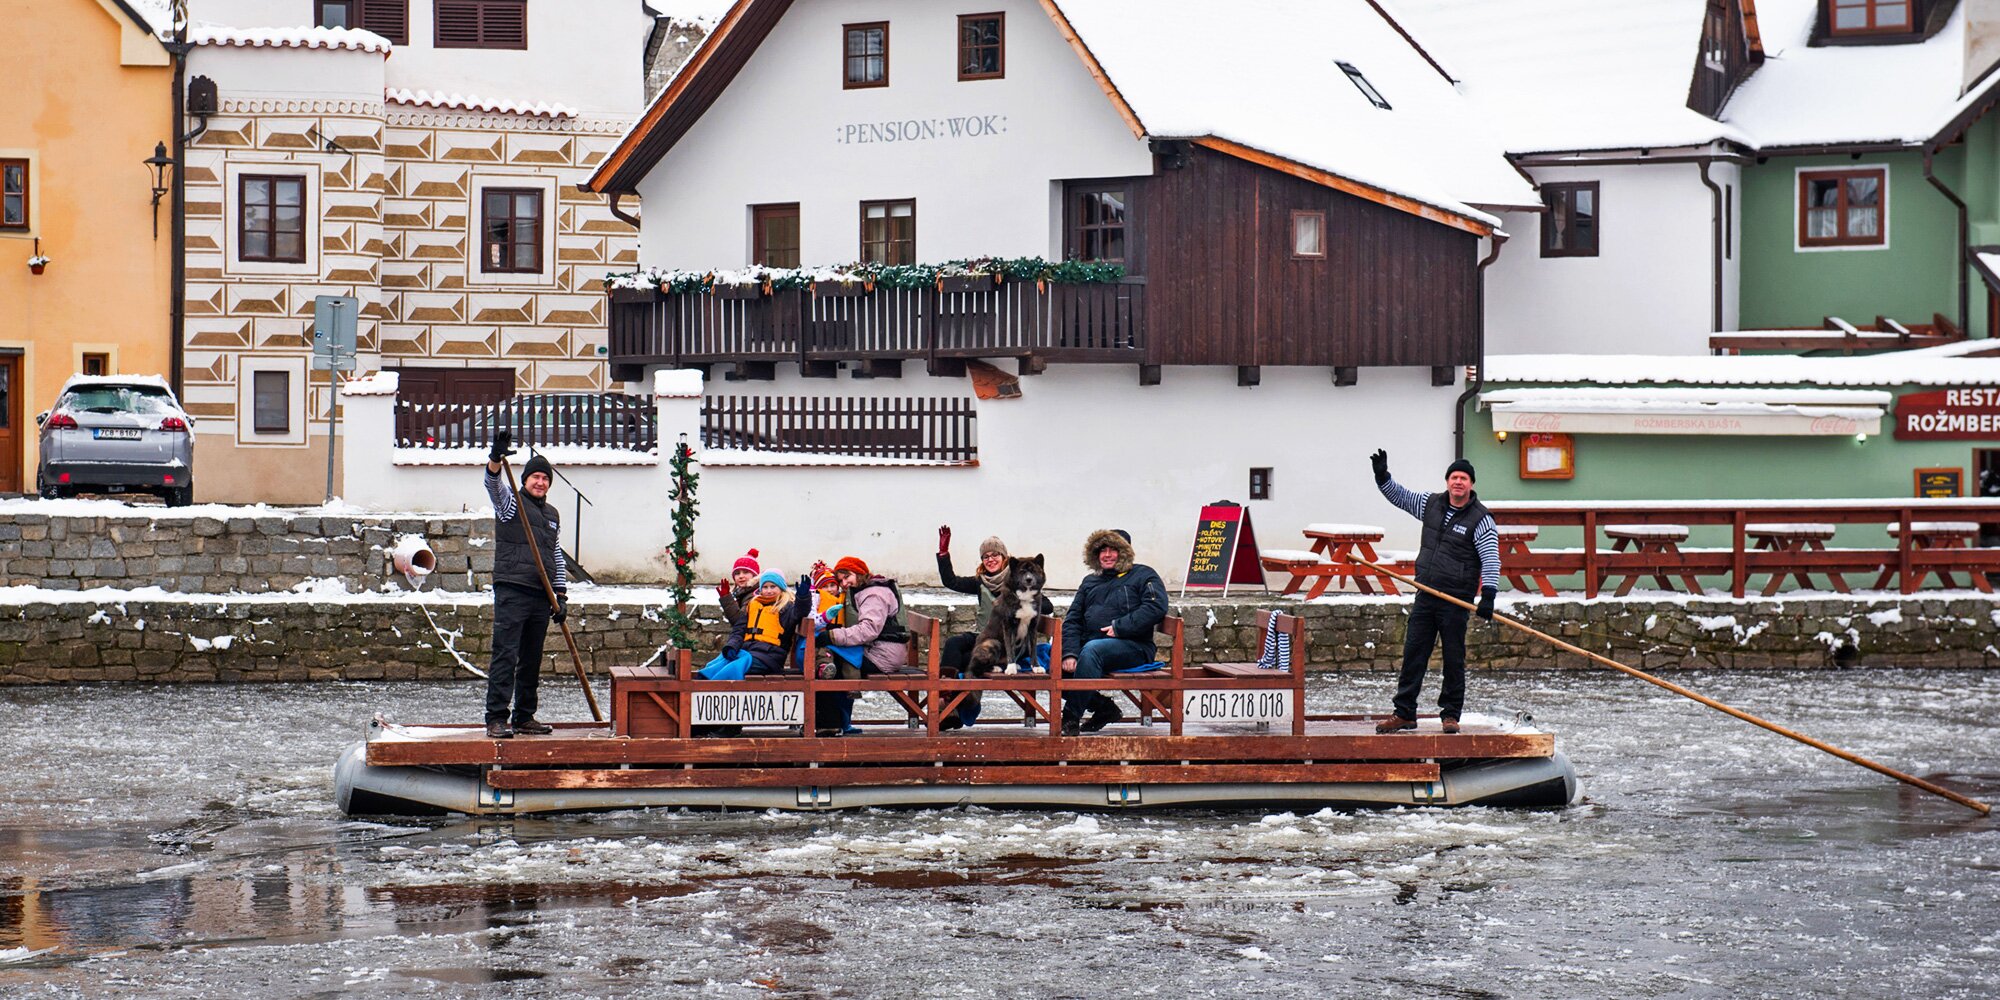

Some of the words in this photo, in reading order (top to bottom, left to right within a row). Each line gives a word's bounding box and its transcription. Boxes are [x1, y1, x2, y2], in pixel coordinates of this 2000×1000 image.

[845, 119, 937, 144] PENSION
[947, 115, 999, 138] WOK
[696, 694, 799, 721] VOROPLAVBA.CZ
[1200, 693, 1226, 718] 605
[1231, 693, 1254, 717] 218
[1260, 692, 1283, 717] 018
